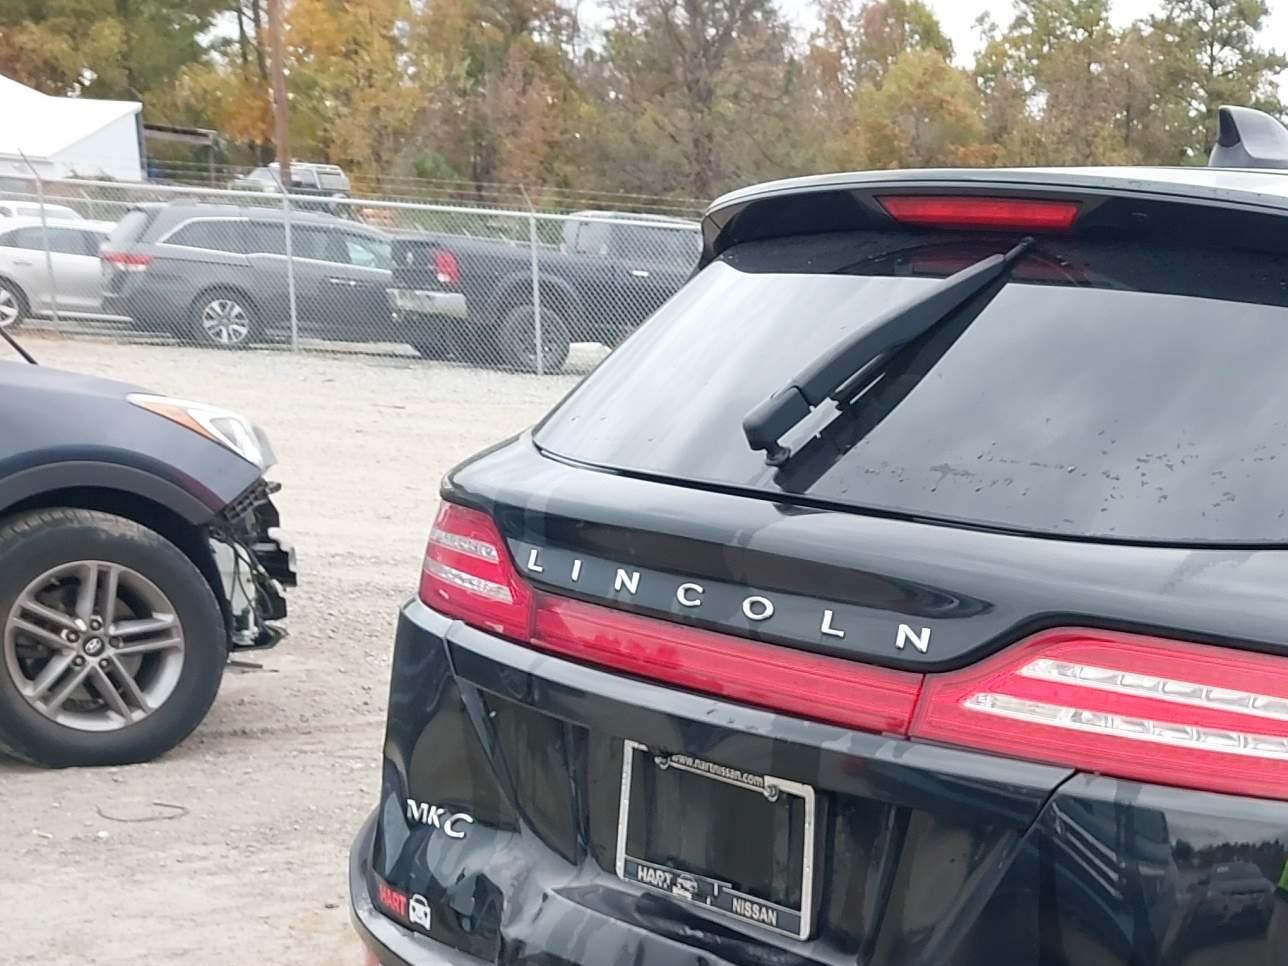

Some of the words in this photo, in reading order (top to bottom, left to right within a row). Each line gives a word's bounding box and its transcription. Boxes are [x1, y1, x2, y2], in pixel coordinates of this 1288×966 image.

[527, 548, 932, 654] LINCOLN
[407, 798, 474, 839] MKC
[637, 865, 673, 890] HART
[732, 897, 778, 927] NISSAN
